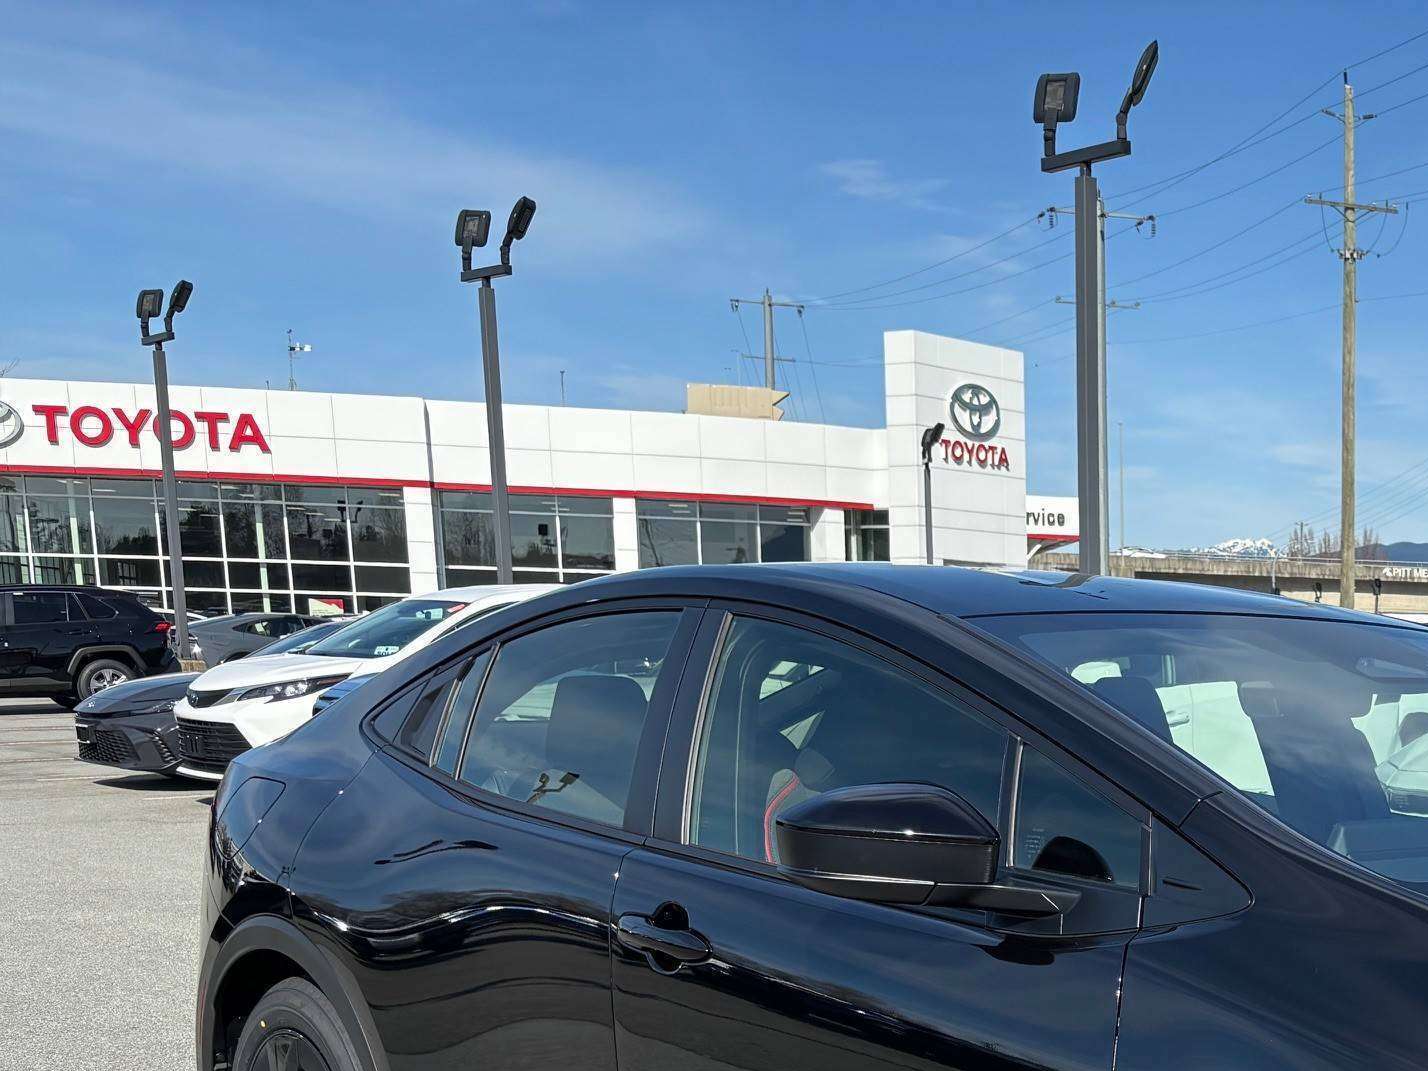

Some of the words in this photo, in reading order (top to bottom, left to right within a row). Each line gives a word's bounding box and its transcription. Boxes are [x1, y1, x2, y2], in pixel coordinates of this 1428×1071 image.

[32, 405, 271, 453] TOYOTA
[940, 438, 1009, 470] TOYOTA
[1026, 508, 1065, 526] rvice
[1393, 567, 1412, 578] PITT
